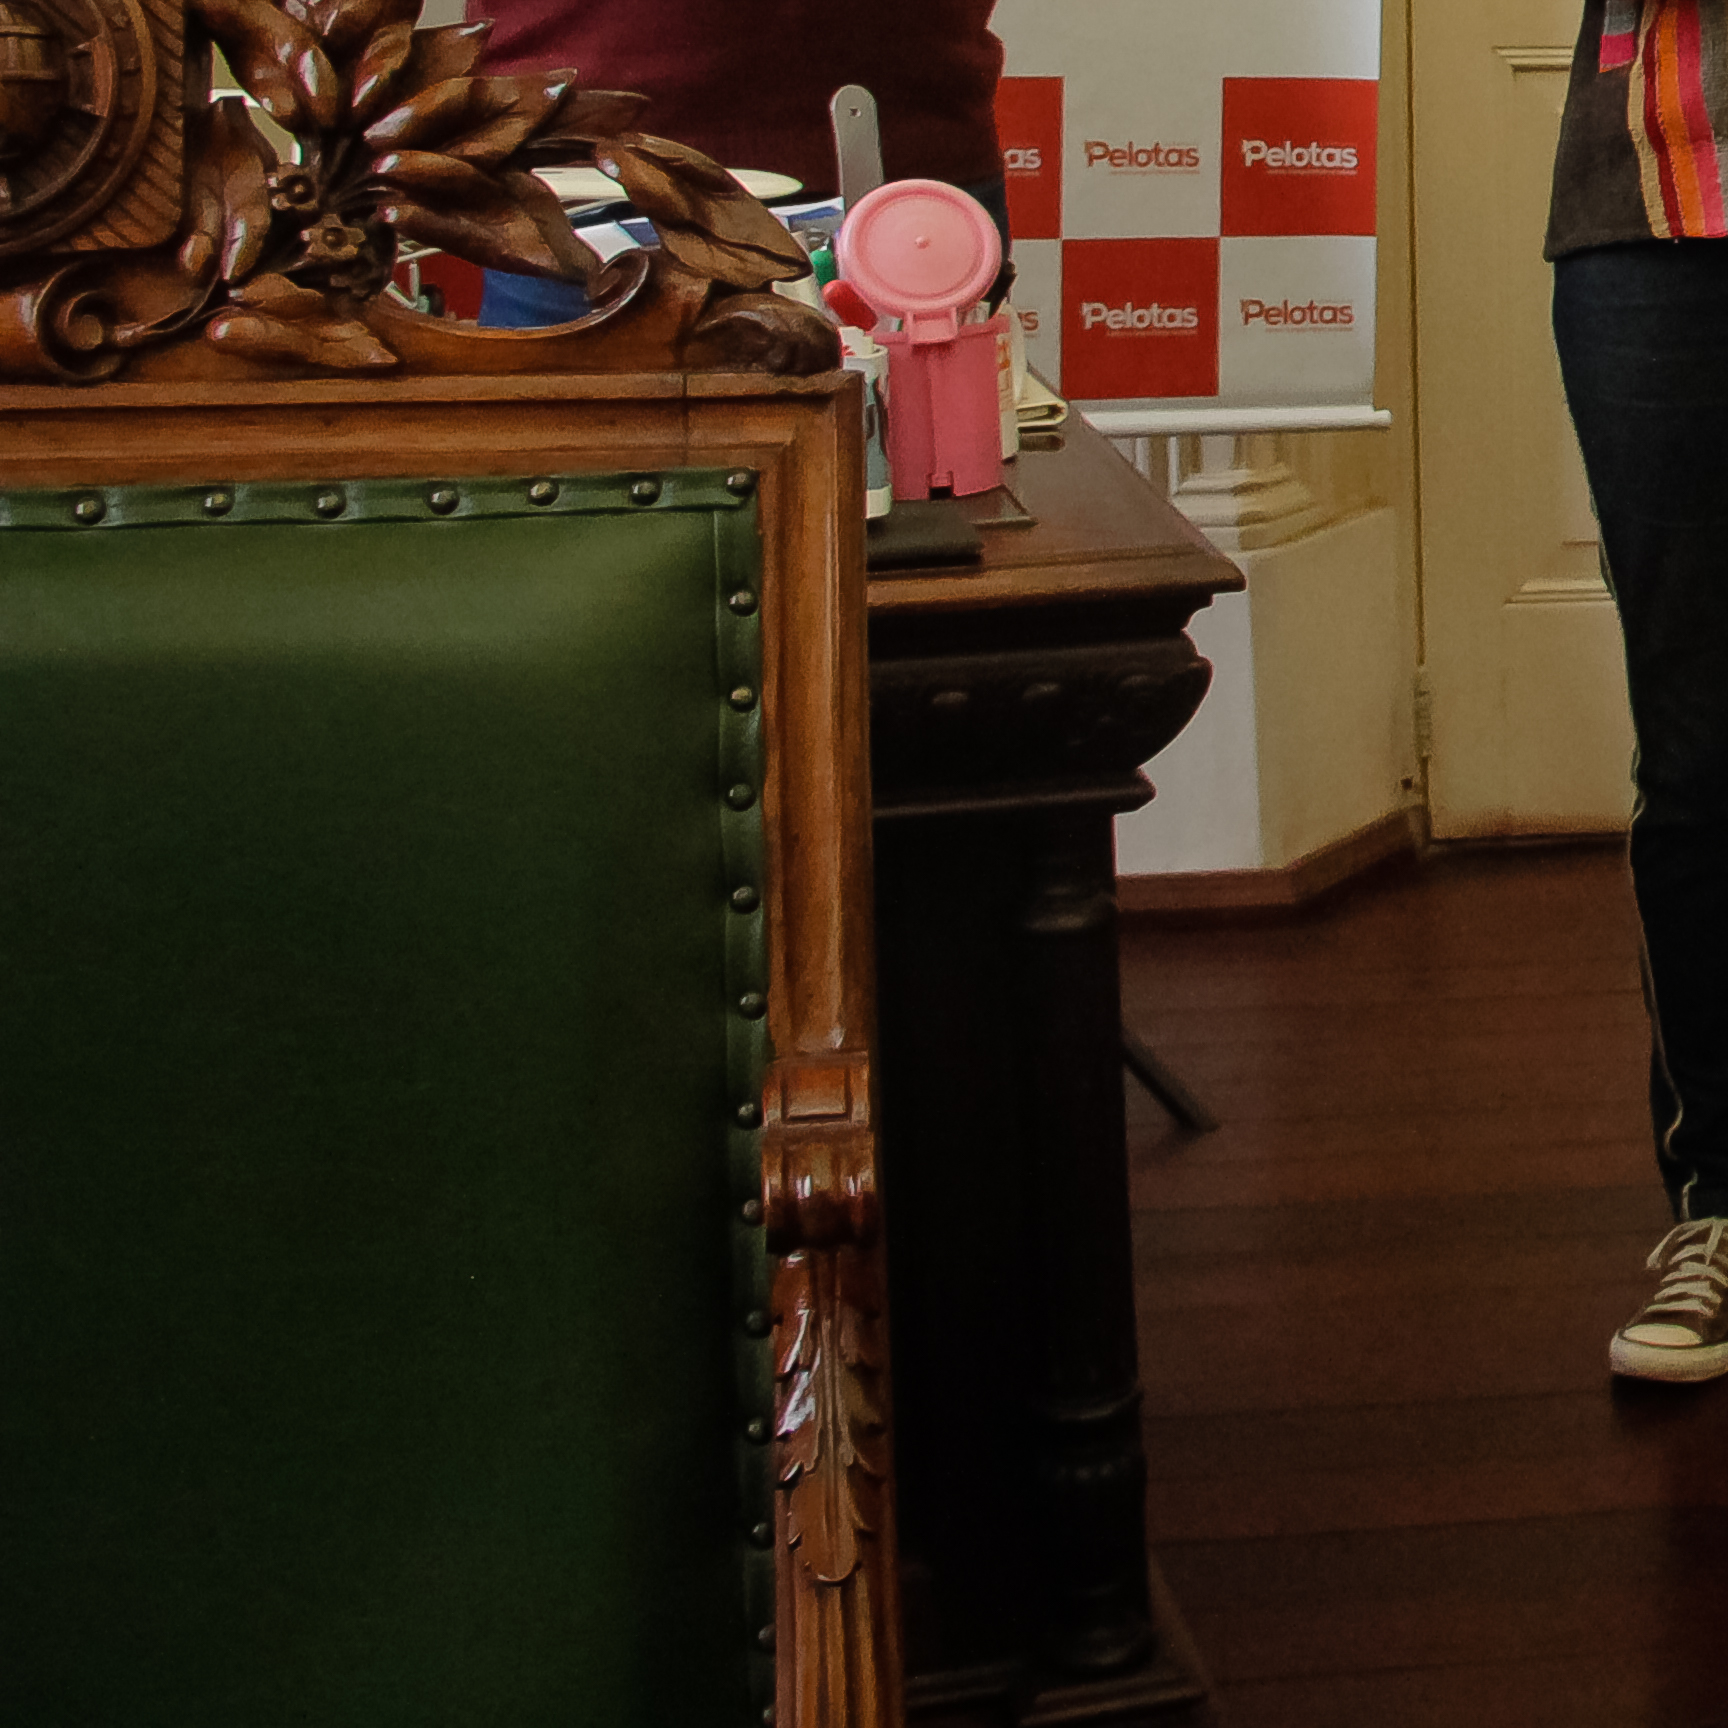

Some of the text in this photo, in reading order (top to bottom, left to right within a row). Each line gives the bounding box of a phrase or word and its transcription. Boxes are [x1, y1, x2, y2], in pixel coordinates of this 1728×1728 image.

[1084, 140, 1200, 169] Pelotas
[1242, 139, 1358, 168] Pelotas
[1081, 302, 1199, 332] Pelotas
[1240, 299, 1355, 326] Pelotas
